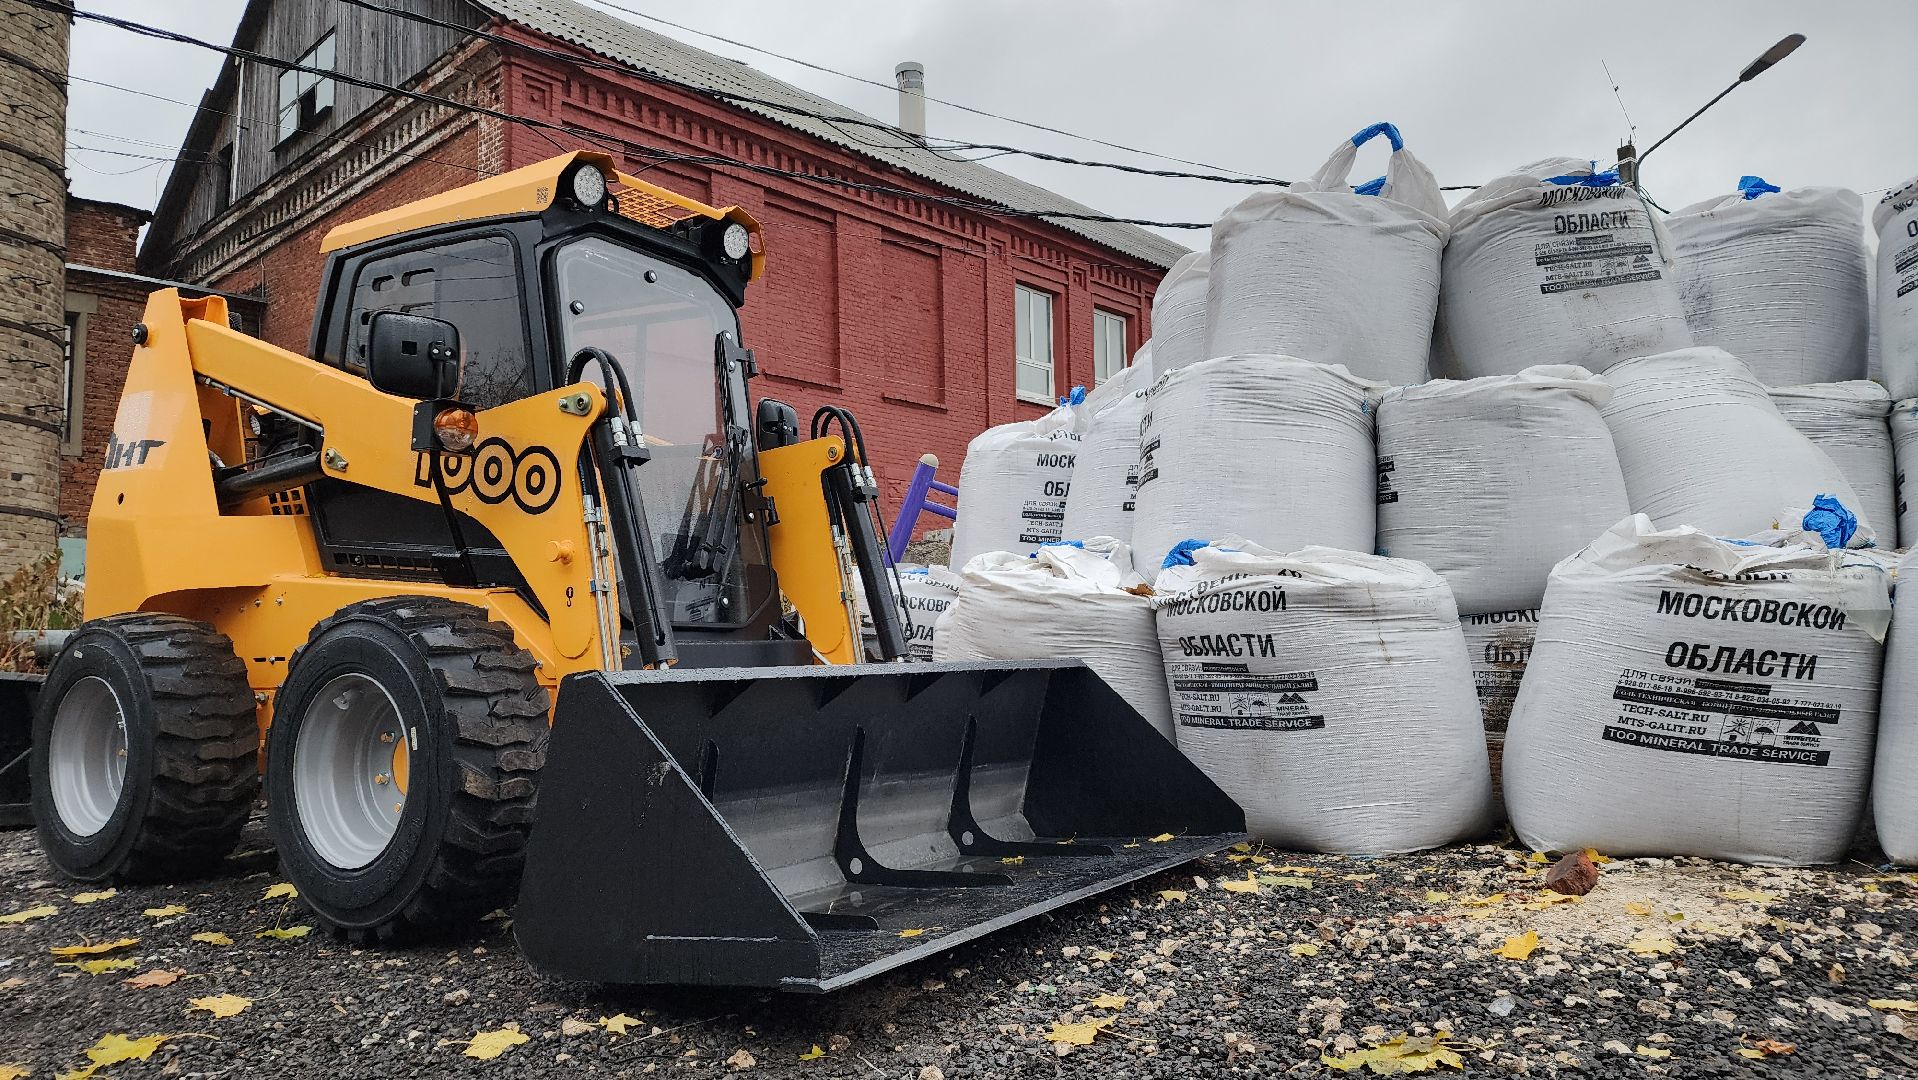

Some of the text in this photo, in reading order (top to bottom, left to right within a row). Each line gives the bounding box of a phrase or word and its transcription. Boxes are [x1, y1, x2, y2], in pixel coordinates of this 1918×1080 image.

[1554, 210, 1631, 234] ОБЛАСТИ
[1167, 586, 1287, 617] МОСКОВСКОЙ
[1179, 633, 1276, 657] ОБЛАСТИ
[1665, 642, 1818, 680] ОБЛАСТИ
[1620, 668, 1647, 680] ДЛЯ
[1192, 716, 1227, 727] MINERAL
[1228, 718, 1262, 728] TRADE
[1264, 719, 1313, 728] SERVICE
[1622, 703, 1710, 723] TECH-SALT.RU
[1617, 716, 1707, 735] MTS-GALIT.RU
[1608, 728, 1818, 762] TOO MINERAL TRADE SERVICE
